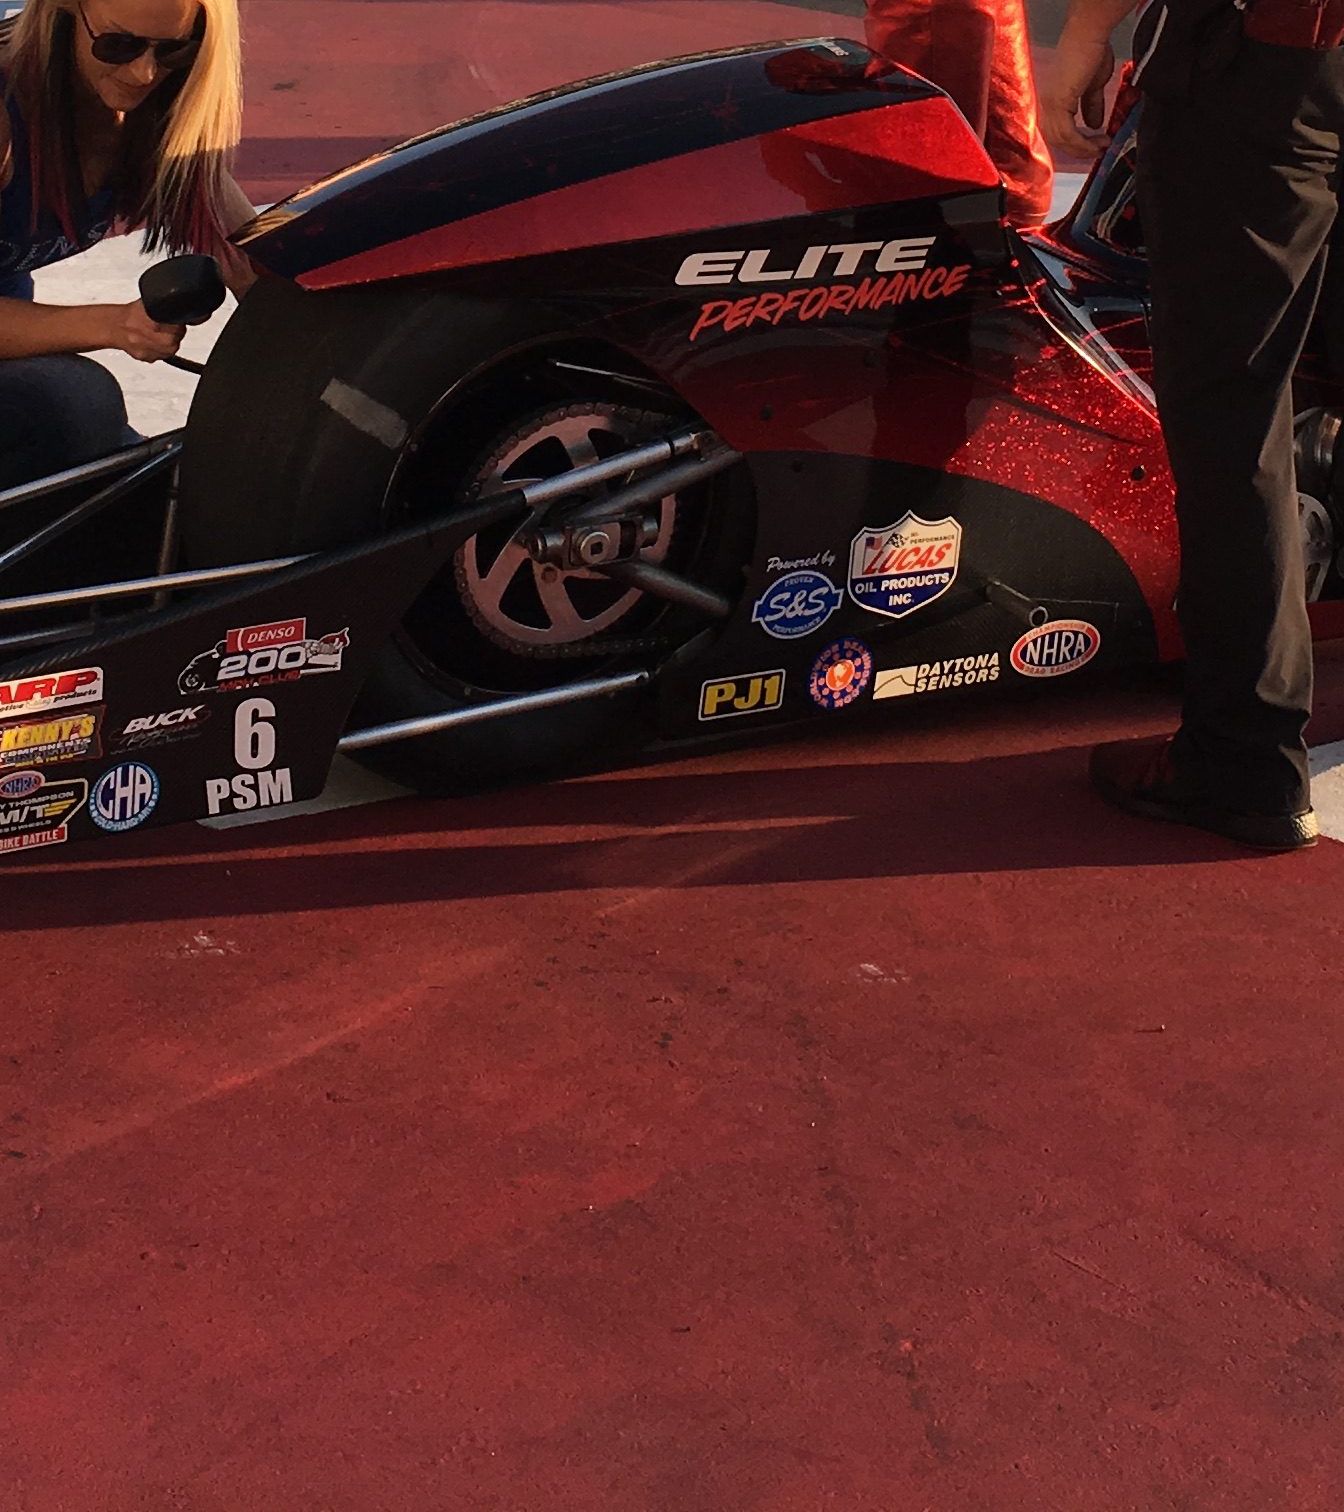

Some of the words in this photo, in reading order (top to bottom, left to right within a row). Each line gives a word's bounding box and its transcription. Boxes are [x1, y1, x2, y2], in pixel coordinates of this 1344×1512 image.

[674, 236, 937, 286] ELITE
[690, 264, 972, 341] PERFORMANCE
[766, 555, 819, 573] Powered
[821, 549, 836, 566] by
[862, 542, 952, 576] LUCAS
[784, 575, 814, 587] PROVEN
[854, 582, 877, 595] OIL
[880, 572, 950, 592] PRODUCTS
[764, 587, 830, 622] S&S
[247, 626, 296, 644] DENSO
[771, 616, 822, 634] PERFORMANCE
[1025, 631, 1086, 665] NHRA
[217, 646, 306, 681] 200
[918, 653, 999, 678] DAYTONA
[1050, 656, 1087, 675] RACING
[259, 670, 301, 687] CLUB
[915, 667, 1000, 692] SENSORS
[53, 688, 97, 703] products
[704, 675, 780, 715] PJ1
[123, 705, 205, 735] BUCK
[0, 715, 95, 752] KENNY'S
[234, 697, 276, 770] 6
[6, 777, 39, 793] NHRA
[101, 764, 152, 820] CHA
[206, 768, 293, 815] PSM
[8, 791, 75, 809] THOMPSON
[22, 830, 59, 845] BATTLE
